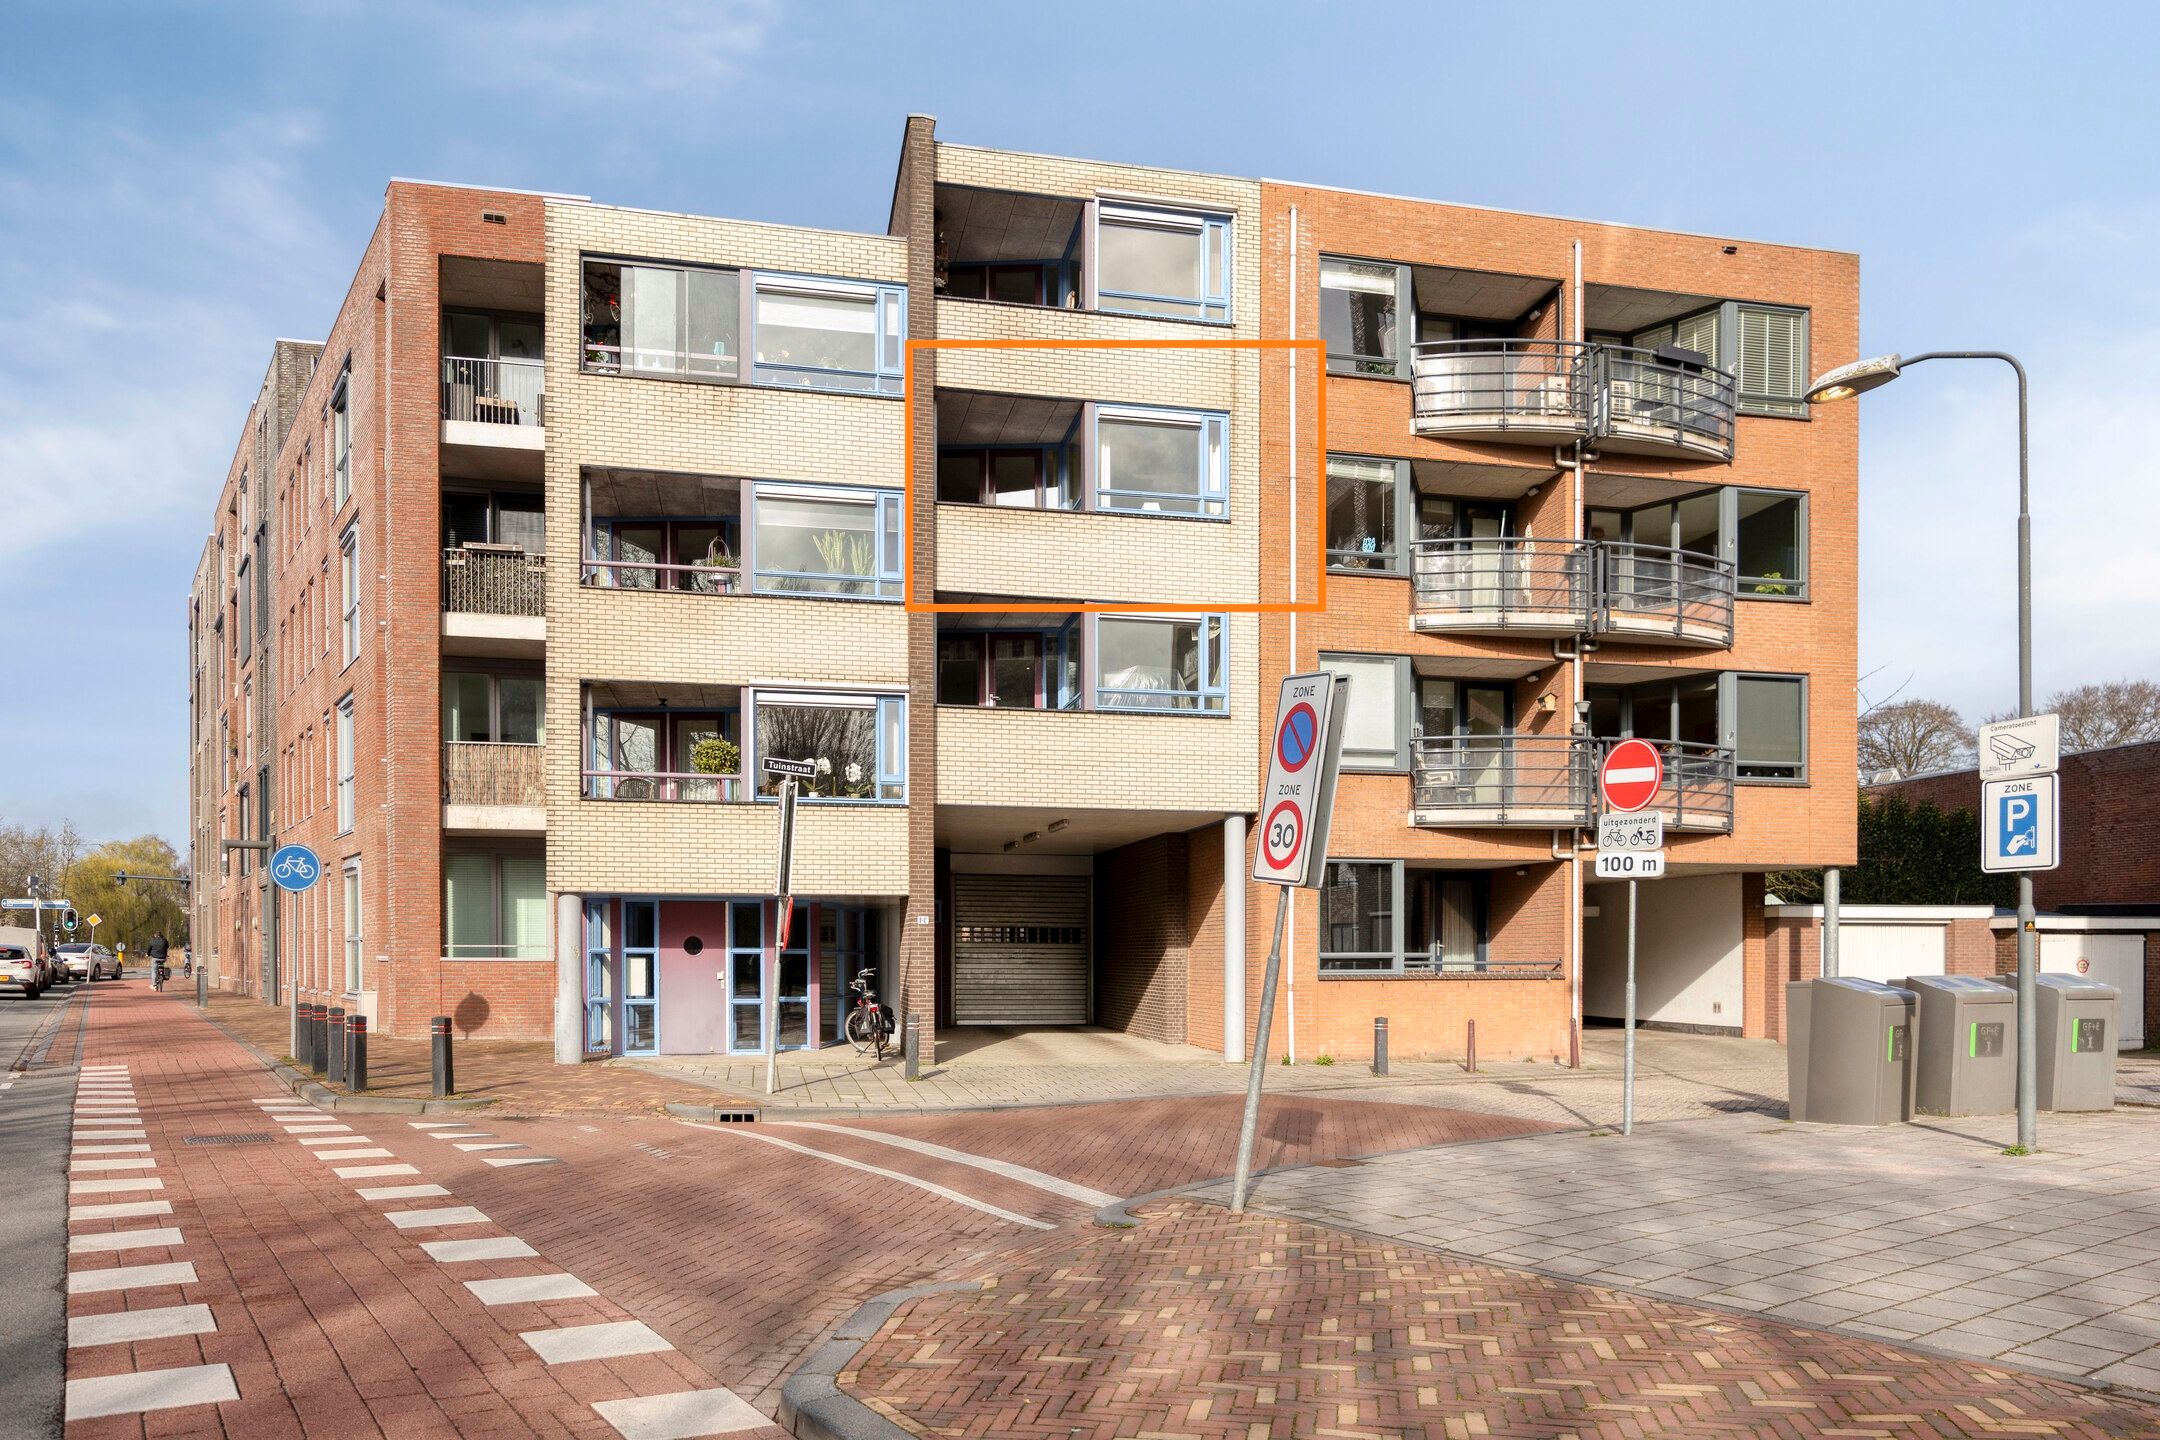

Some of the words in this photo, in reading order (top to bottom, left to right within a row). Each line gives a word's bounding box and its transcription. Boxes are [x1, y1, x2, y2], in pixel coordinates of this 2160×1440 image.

[1292, 685, 1316, 698] ZONE
[1990, 720, 2037, 732] Cameratoezicht
[768, 760, 811, 774] Tuinstraat
[1278, 784, 1302, 796] ZONE
[2004, 782, 2033, 794] ZONE
[2007, 798, 2030, 832] P
[1603, 816, 1657, 828] uitgezonderd
[1270, 823, 1295, 848] 30
[1602, 856, 1634, 872] 100
[1642, 858, 1657, 871] m
